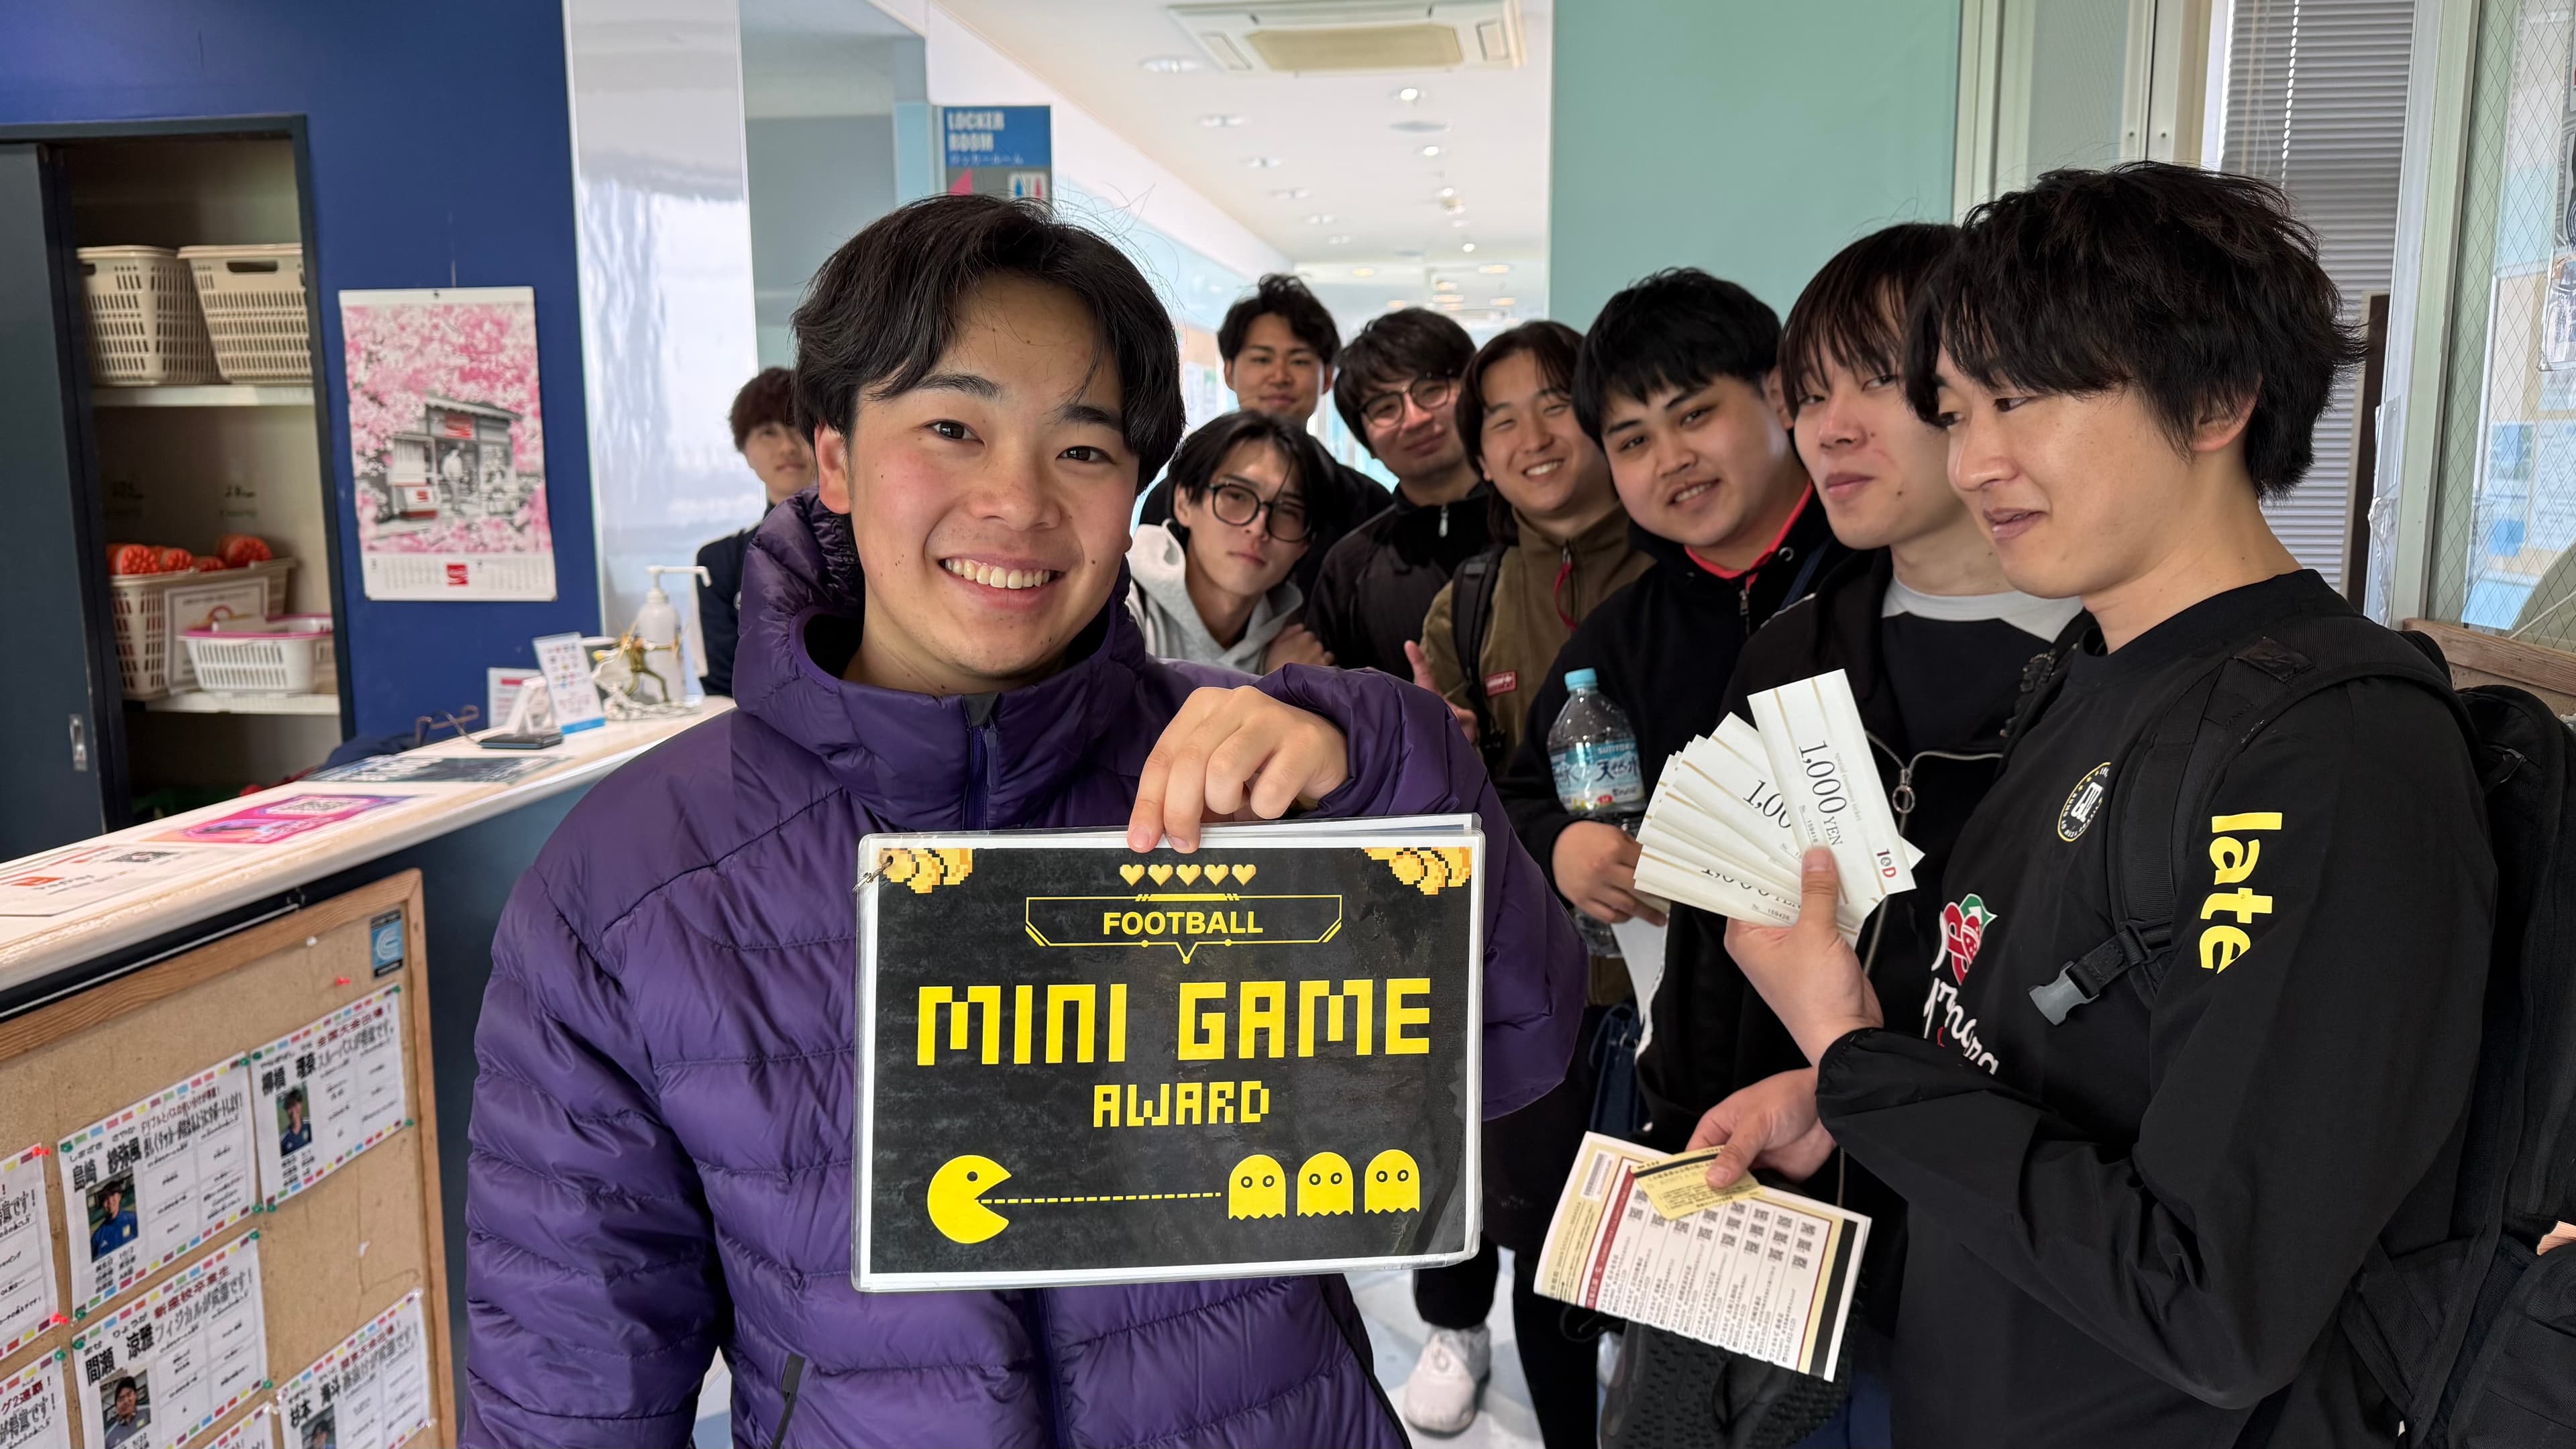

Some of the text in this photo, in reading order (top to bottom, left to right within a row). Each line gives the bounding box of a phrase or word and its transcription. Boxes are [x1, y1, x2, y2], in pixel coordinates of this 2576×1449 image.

[947, 111, 1005, 131] LOCKER
[949, 132, 994, 152] ROOM
[1799, 741, 1847, 846] 1,000 YEN
[2200, 812, 2282, 974] late
[1103, 910, 1264, 936] FOOTBALL
[917, 978, 1431, 1066] MINI GAME
[1093, 1081, 1270, 1128] AWARD
